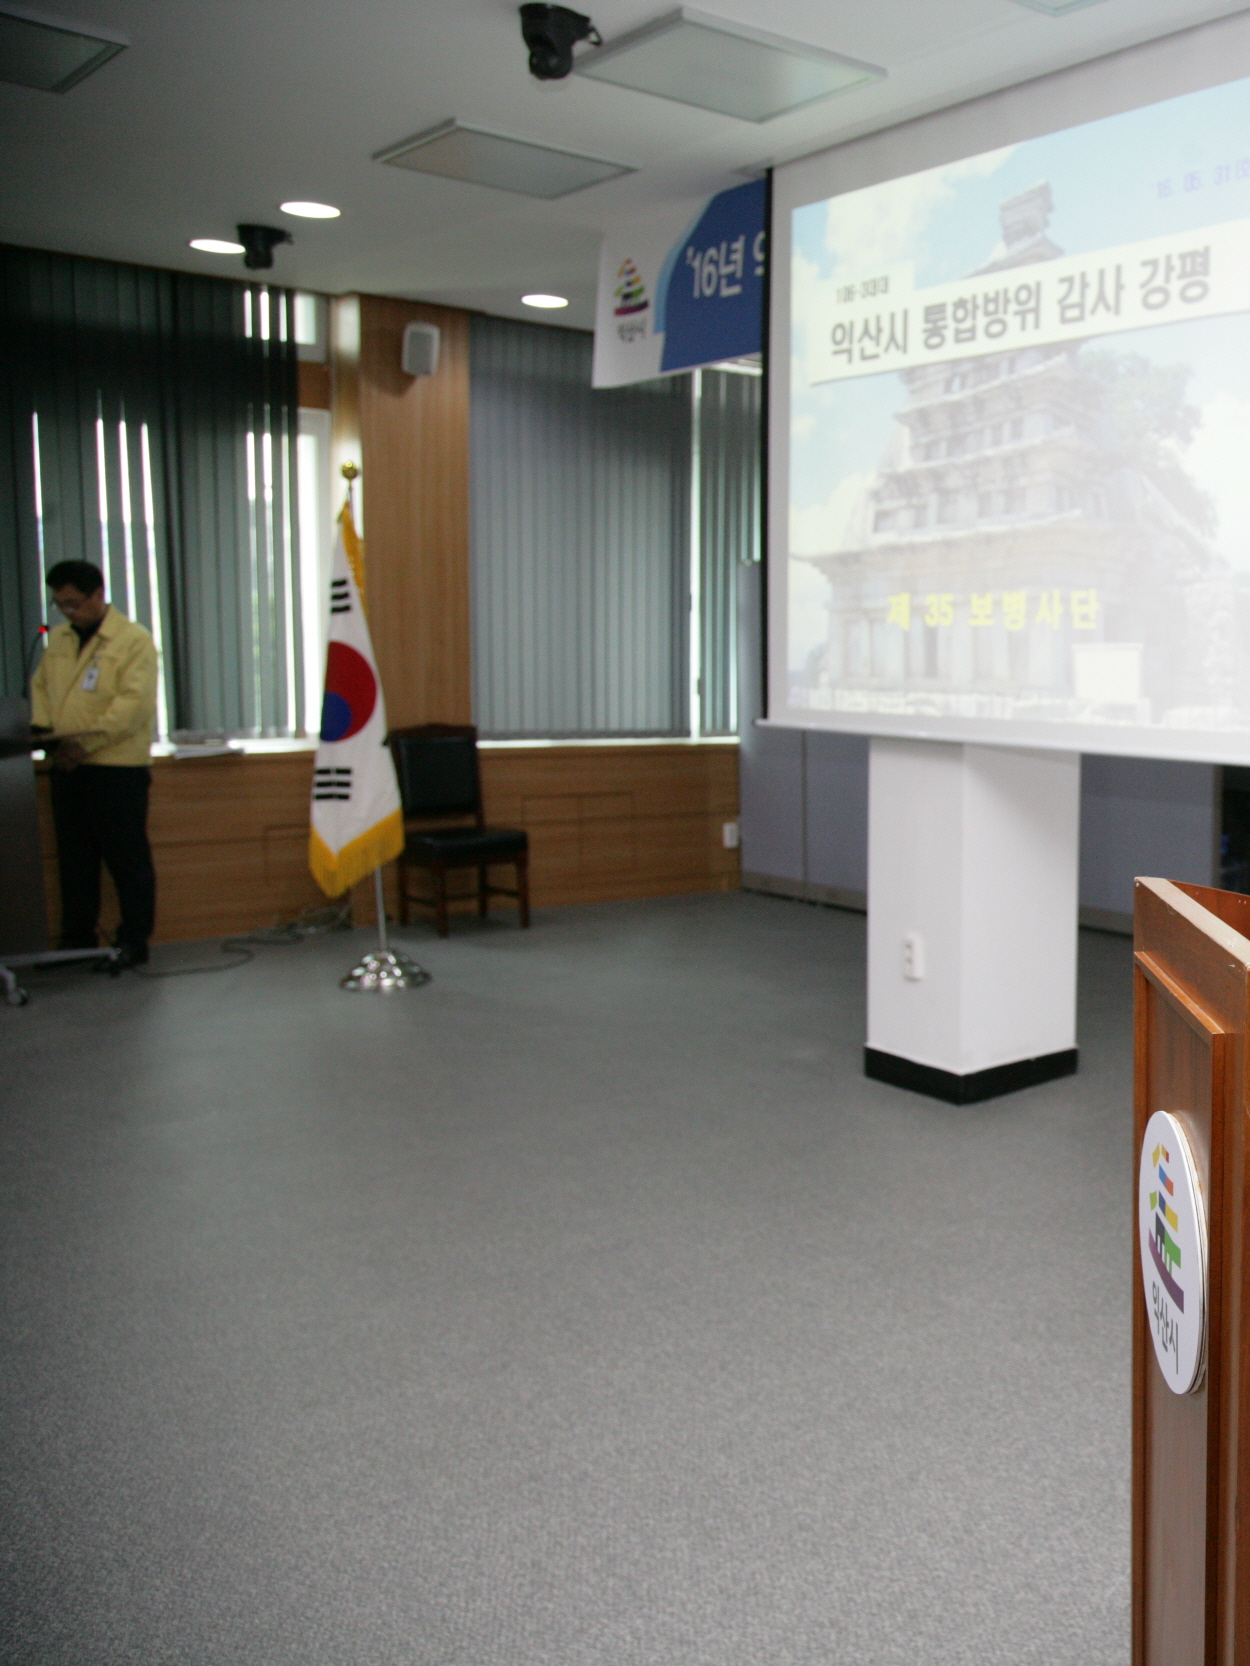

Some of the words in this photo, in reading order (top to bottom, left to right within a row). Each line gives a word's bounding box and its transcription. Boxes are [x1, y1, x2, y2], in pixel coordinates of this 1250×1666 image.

[831, 308, 908, 365] 익산시
[922, 280, 1042, 351] 통합방위
[1057, 264, 1125, 325] 감사
[1139, 245, 1211, 311] 강평
[886, 591, 912, 631] 제
[923, 592, 955, 628] 35
[1152, 1280, 1179, 1375] 익산시
